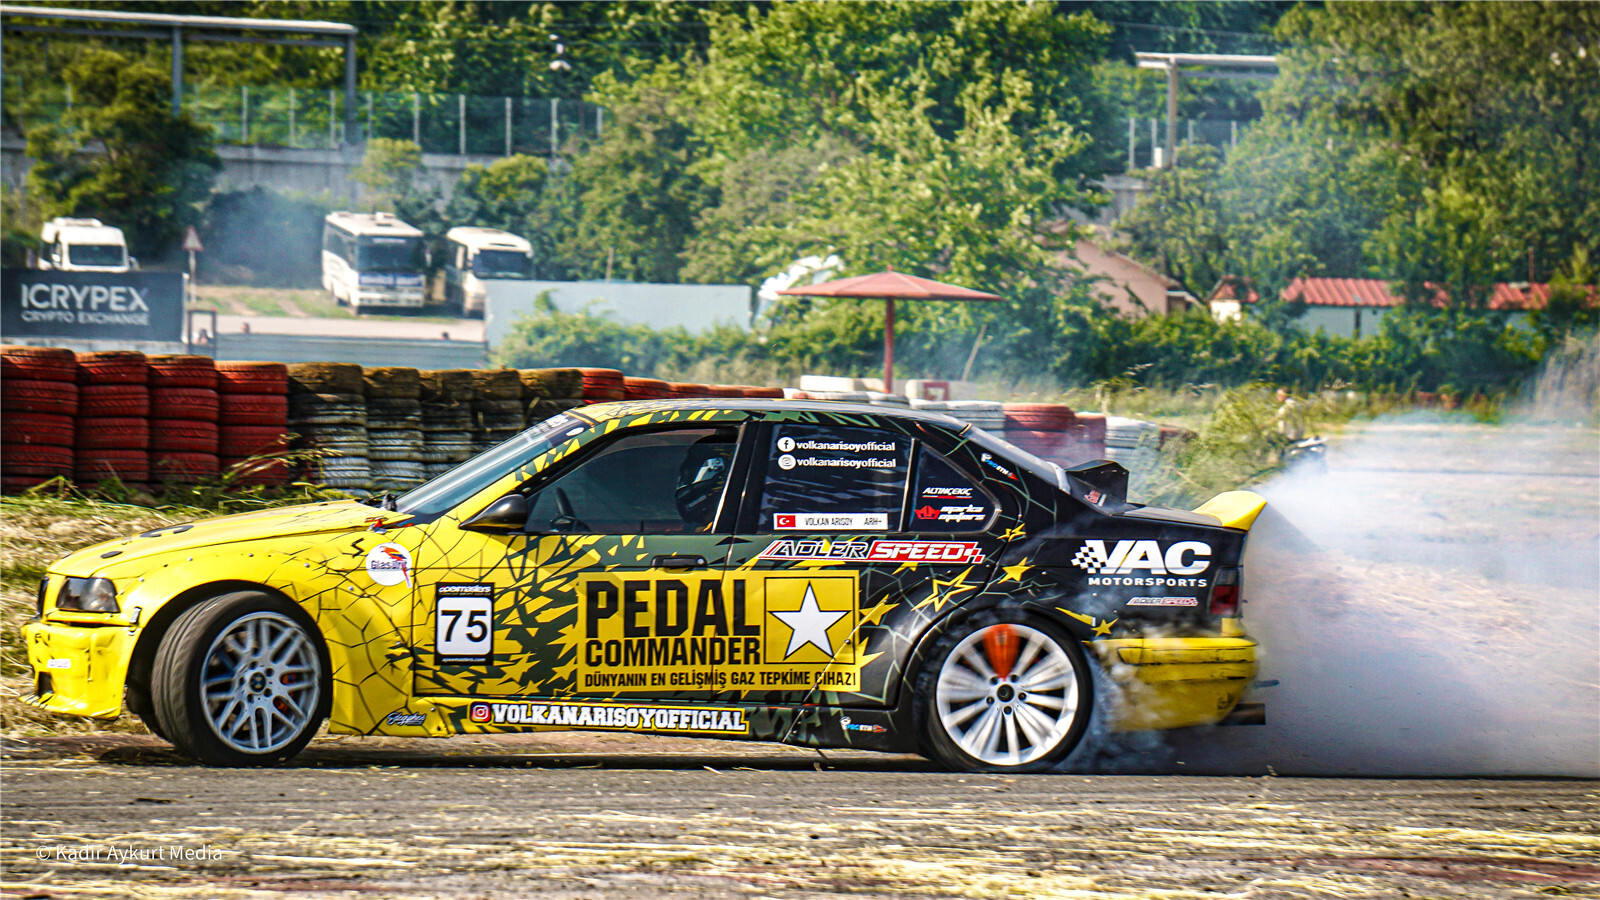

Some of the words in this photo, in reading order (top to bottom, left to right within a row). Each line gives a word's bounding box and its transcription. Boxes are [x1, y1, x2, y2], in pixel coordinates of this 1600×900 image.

[21, 283, 149, 312] ICRYPEX
[21, 310, 75, 323] CRYPTO
[78, 311, 149, 326] EXCHANGE
[796, 440, 895, 452] volkanarisoyofficial
[797, 457, 897, 469] volkanarisoyofficial
[804, 517, 830, 526] VOLKAN
[831, 517, 853, 526] ARISOY
[774, 540, 869, 559] ADLER
[869, 543, 967, 560] SPEED
[1077, 540, 1212, 575] VAC
[1088, 577, 1208, 588] MOTORSPORTS
[586, 579, 760, 639] PEDAL
[441, 610, 488, 642] 75
[585, 637, 760, 667] COMMANDER
[585, 671, 647, 687] DÜNYANIN
[651, 673, 666, 686] EN
[670, 669, 727, 688] GELİŞMİŞ
[731, 672, 755, 685] GAZ
[759, 668, 810, 685] TEPKİME
[492, 703, 746, 731] VOLKANARISOYOFFICIAL
